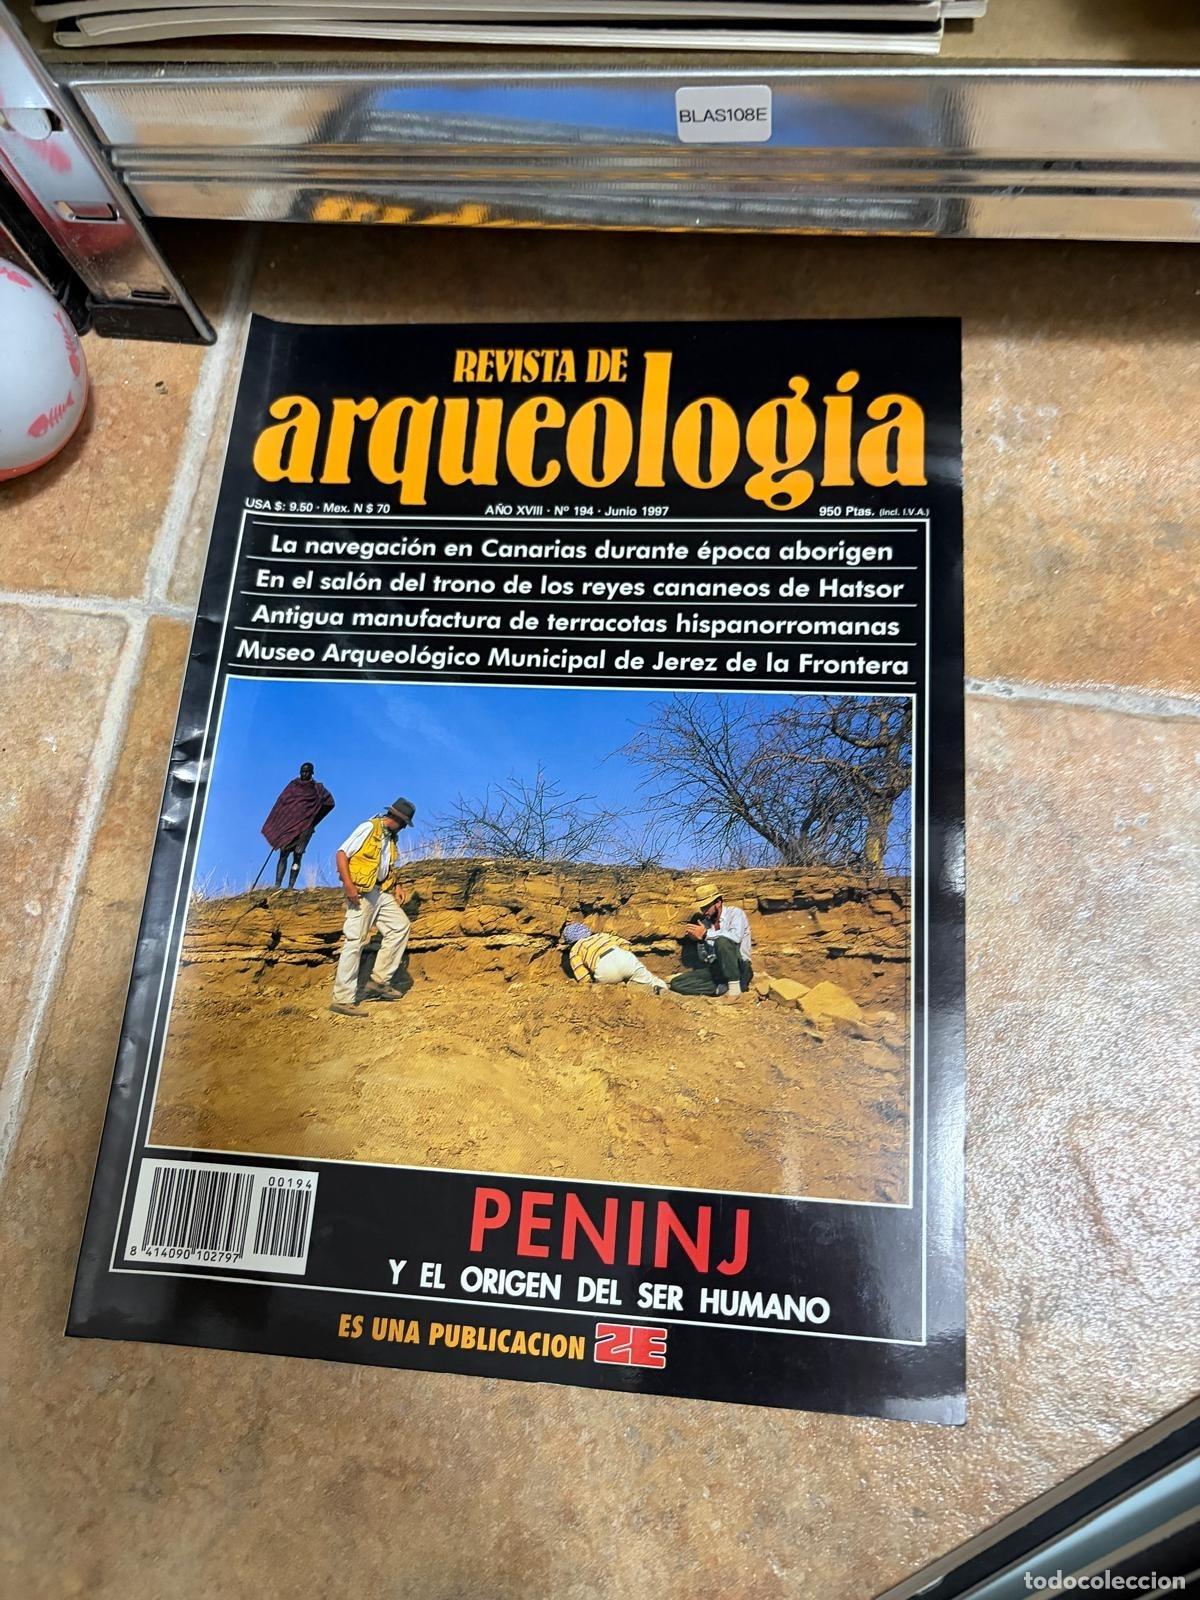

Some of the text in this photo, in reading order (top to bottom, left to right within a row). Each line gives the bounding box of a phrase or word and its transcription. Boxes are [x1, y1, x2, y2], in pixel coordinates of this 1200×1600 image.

[679, 107, 768, 123] BLAS108E
[453, 349, 629, 384] REVISTA DE
[245, 497, 271, 510] USA
[289, 502, 313, 512] 9.50
[323, 503, 350, 513] Mex.
[354, 503, 363, 513] N
[366, 503, 373, 514] $
[377, 504, 390, 514] 70
[485, 502, 512, 515] AÑO
[516, 505, 543, 515] XVIII
[574, 506, 594, 516] 194
[604, 506, 637, 516] Junio
[642, 506, 669, 516] 1997
[819, 506, 841, 516] 950
[845, 506, 875, 517] Ptas.
[271, 534, 893, 566] La navegación en Canarias durante época aborigen
[256, 569, 905, 600] En el salón del trono de los reyes cananeos de Hatsor
[251, 604, 900, 638] Antigua manufactura de terracotas hispanorromanas
[236, 639, 909, 675] Museo Arqueológico Municipal de Jerez de la Frontera
[268, 1176, 312, 1189] 00194
[469, 1187, 751, 1276] PENINJ
[388, 1259, 831, 1324] Y EL ORIGEN DEL SER HUMANO
[338, 1313, 363, 1339] ES
[372, 1316, 420, 1345] UNA
[428, 1321, 586, 1360] PUBLICACION
